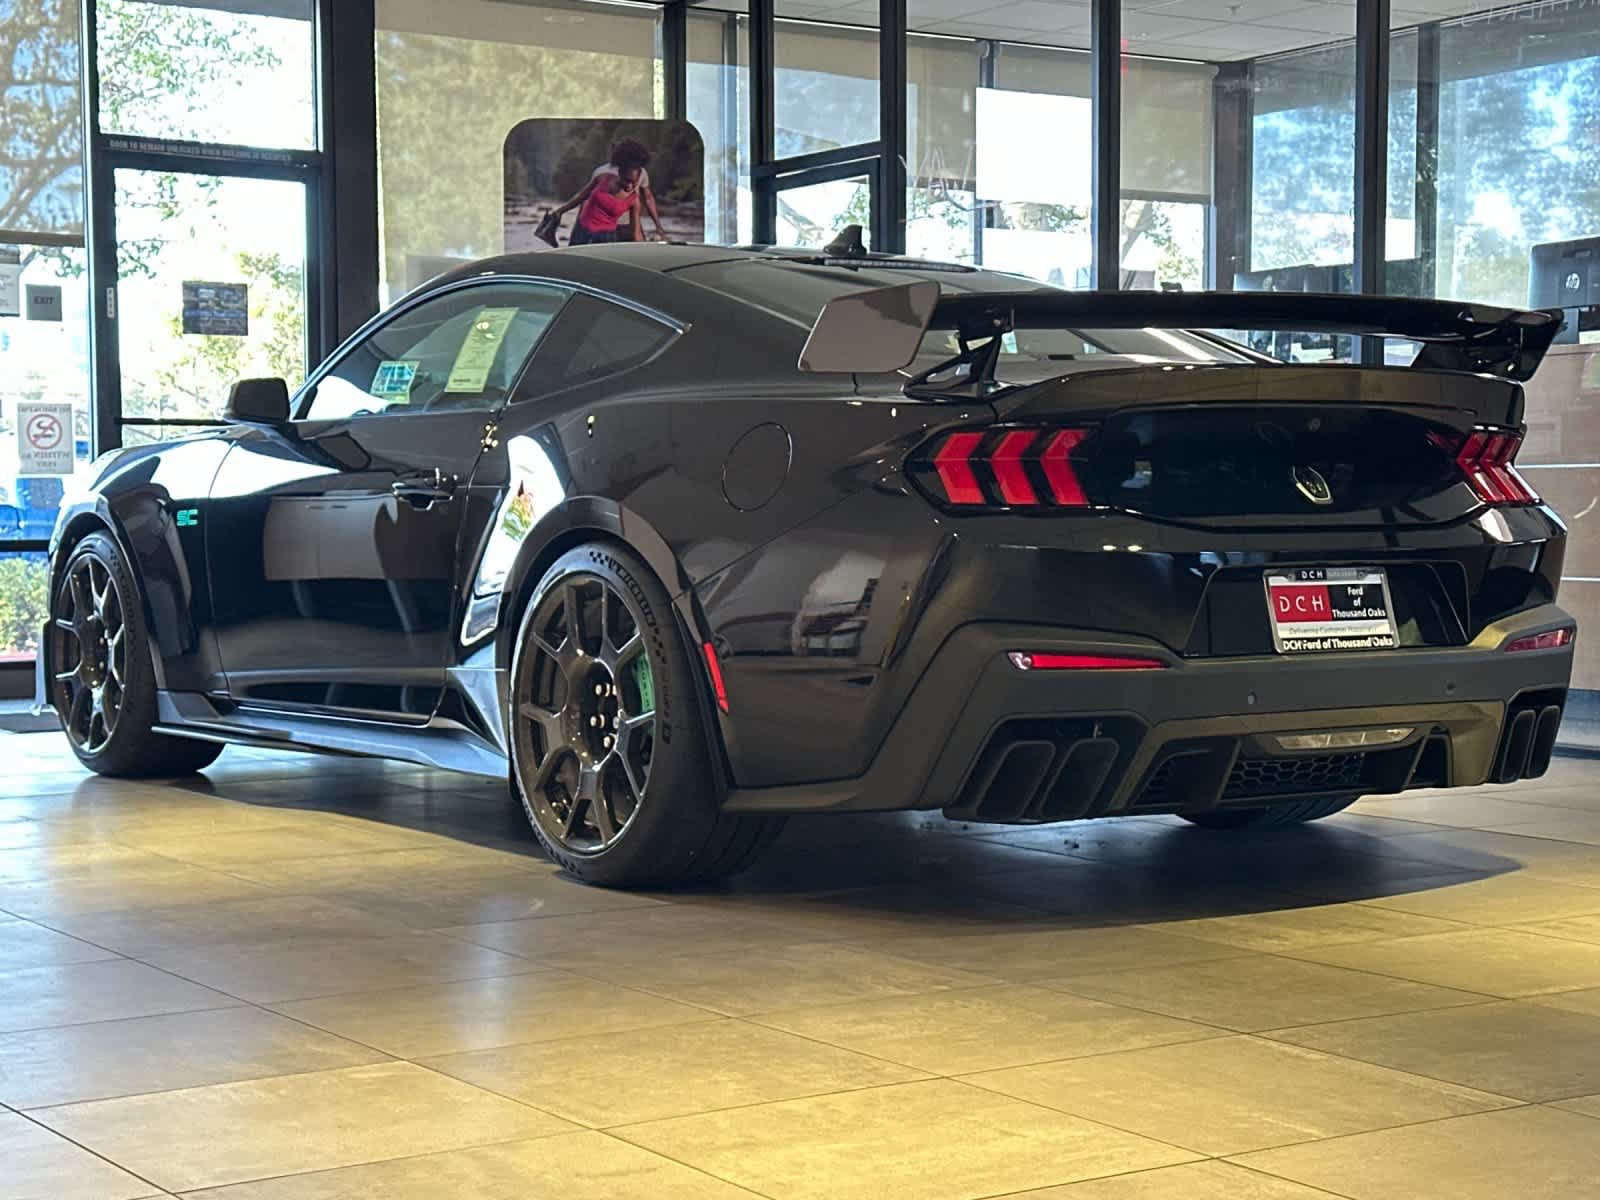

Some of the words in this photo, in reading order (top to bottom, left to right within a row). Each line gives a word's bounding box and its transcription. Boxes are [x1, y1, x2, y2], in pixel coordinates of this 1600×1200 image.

[1347, 586, 1364, 596] Ford
[1353, 597, 1361, 607] of
[1332, 608, 1367, 618] Thousand
[1368, 608, 1386, 617] Oaks
[1283, 640, 1302, 650] DCH
[1322, 638, 1332, 649] of
[1332, 637, 1371, 649] Thousand
